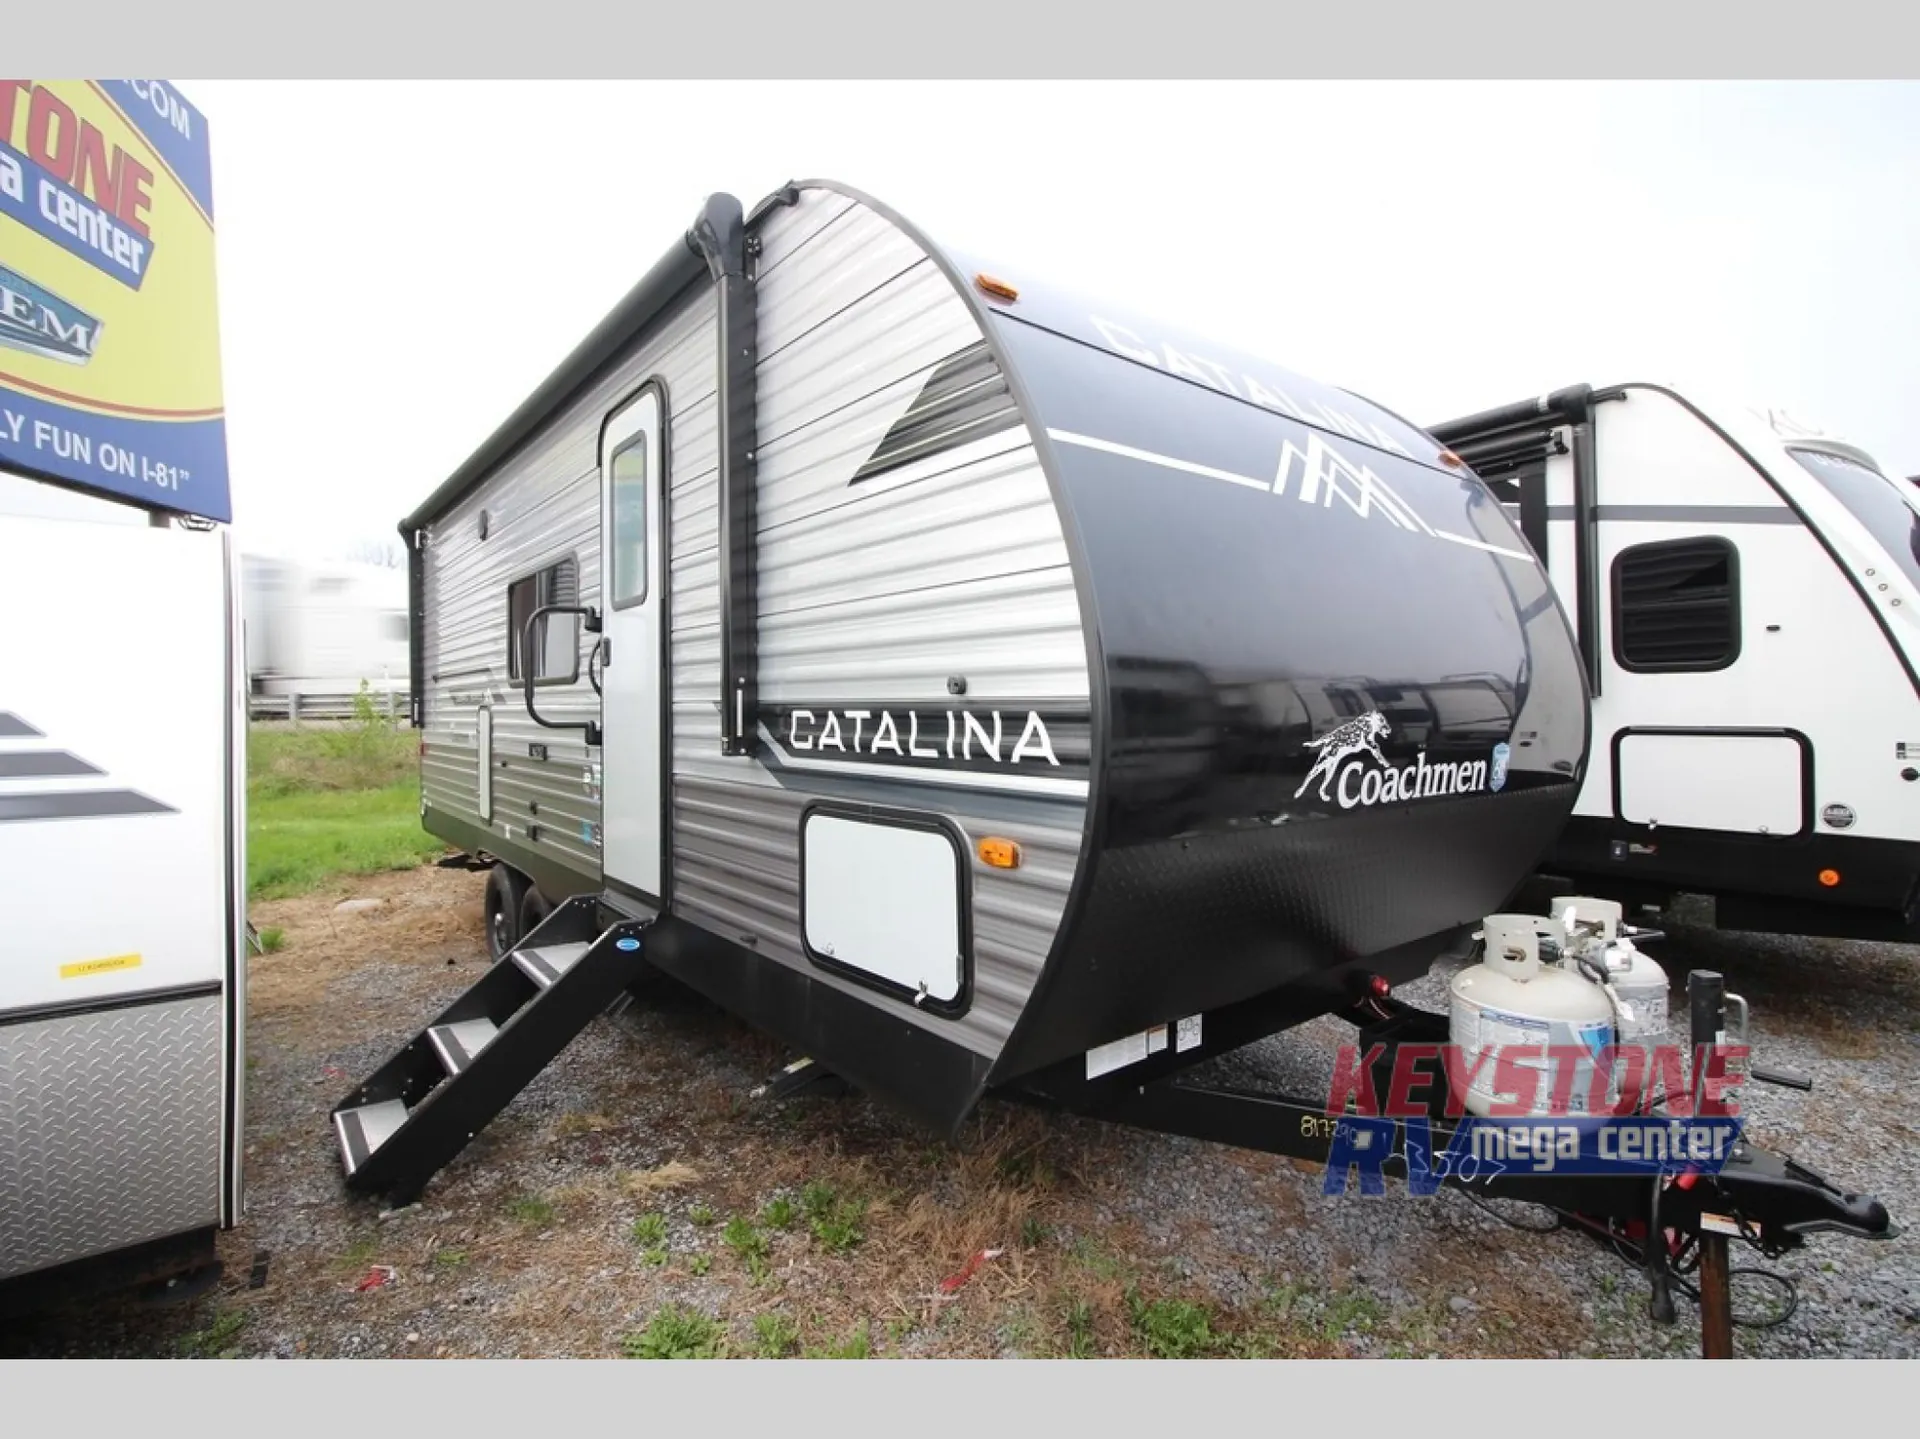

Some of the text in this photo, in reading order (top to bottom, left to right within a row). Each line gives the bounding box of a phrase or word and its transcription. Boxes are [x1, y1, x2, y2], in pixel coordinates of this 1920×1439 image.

[39, 178, 144, 276] center
[1090, 314, 1413, 457] CATALINA
[34, 419, 92, 466] FUN
[100, 444, 136, 479] ON
[790, 709, 1060, 766] CATALINA
[1337, 751, 1487, 809] Coachmen
